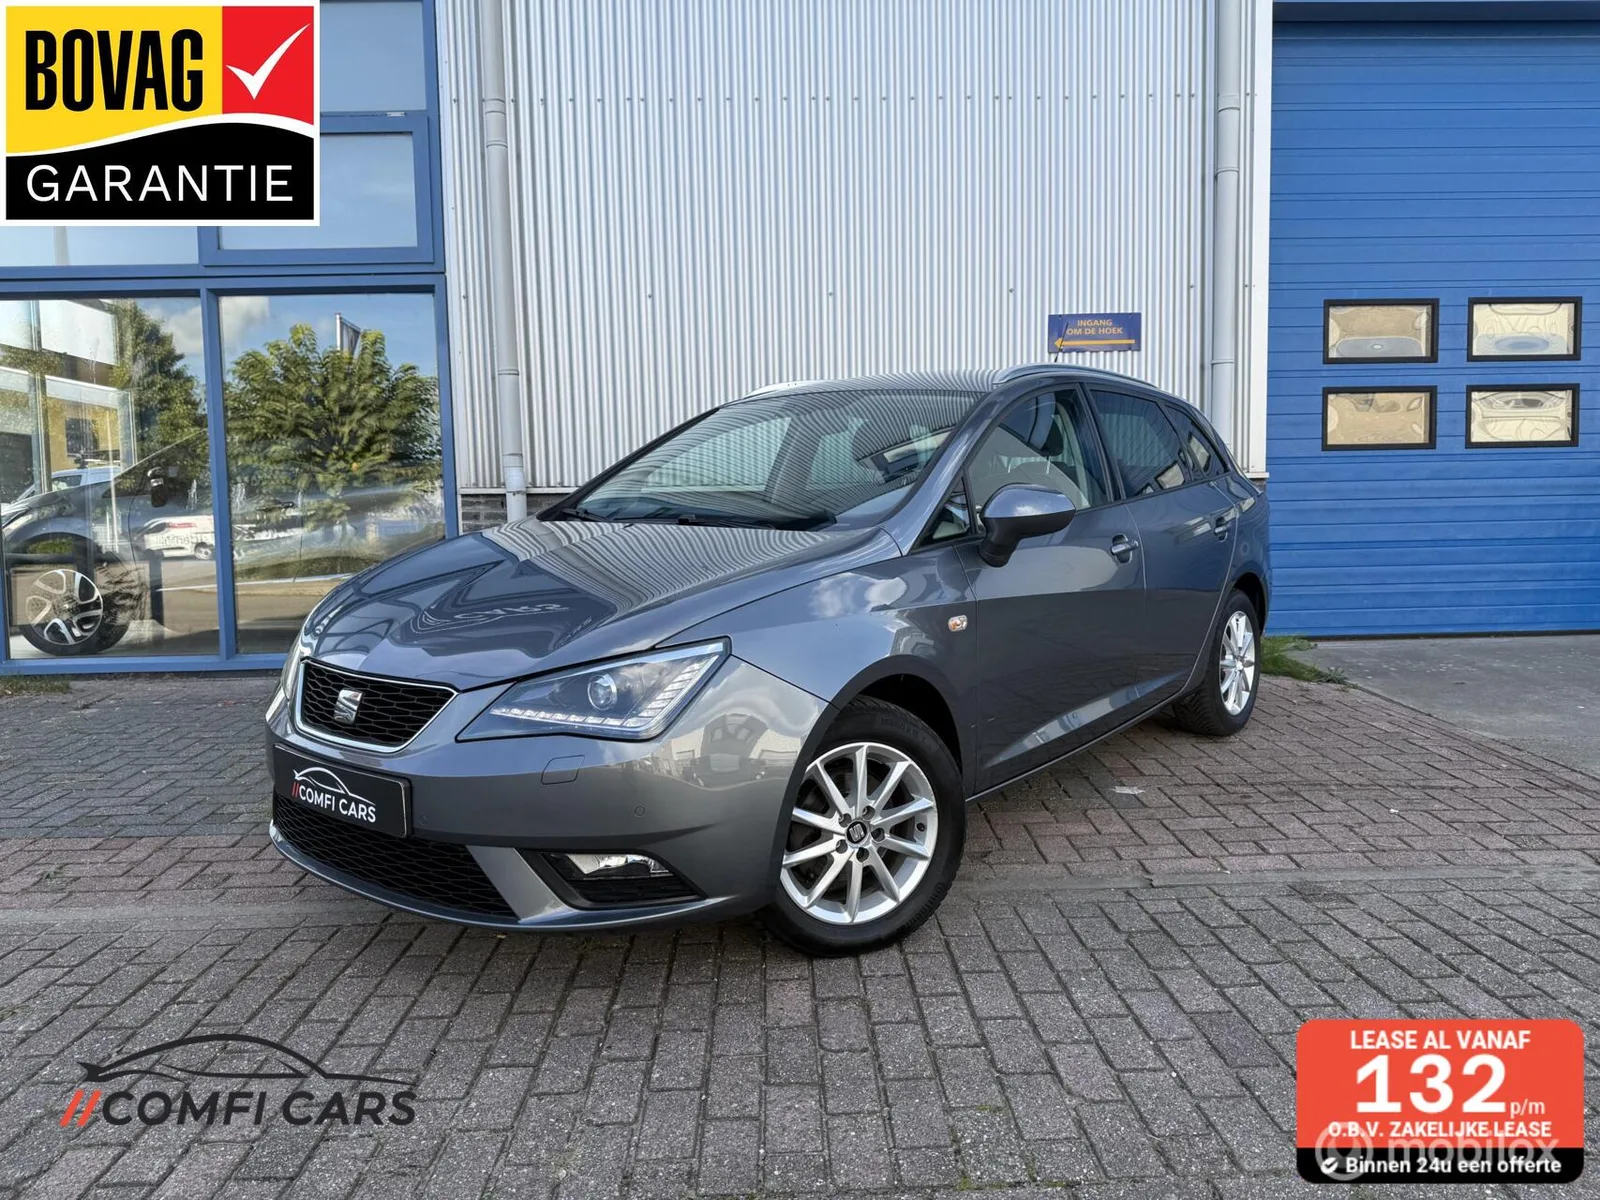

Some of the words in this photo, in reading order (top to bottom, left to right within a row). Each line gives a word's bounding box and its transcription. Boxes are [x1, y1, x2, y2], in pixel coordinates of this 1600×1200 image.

[1077, 318, 1113, 326] INGANG
[1066, 328, 1082, 336] OM
[1098, 327, 1124, 335] HOEK
[338, 798, 377, 823] CARS
